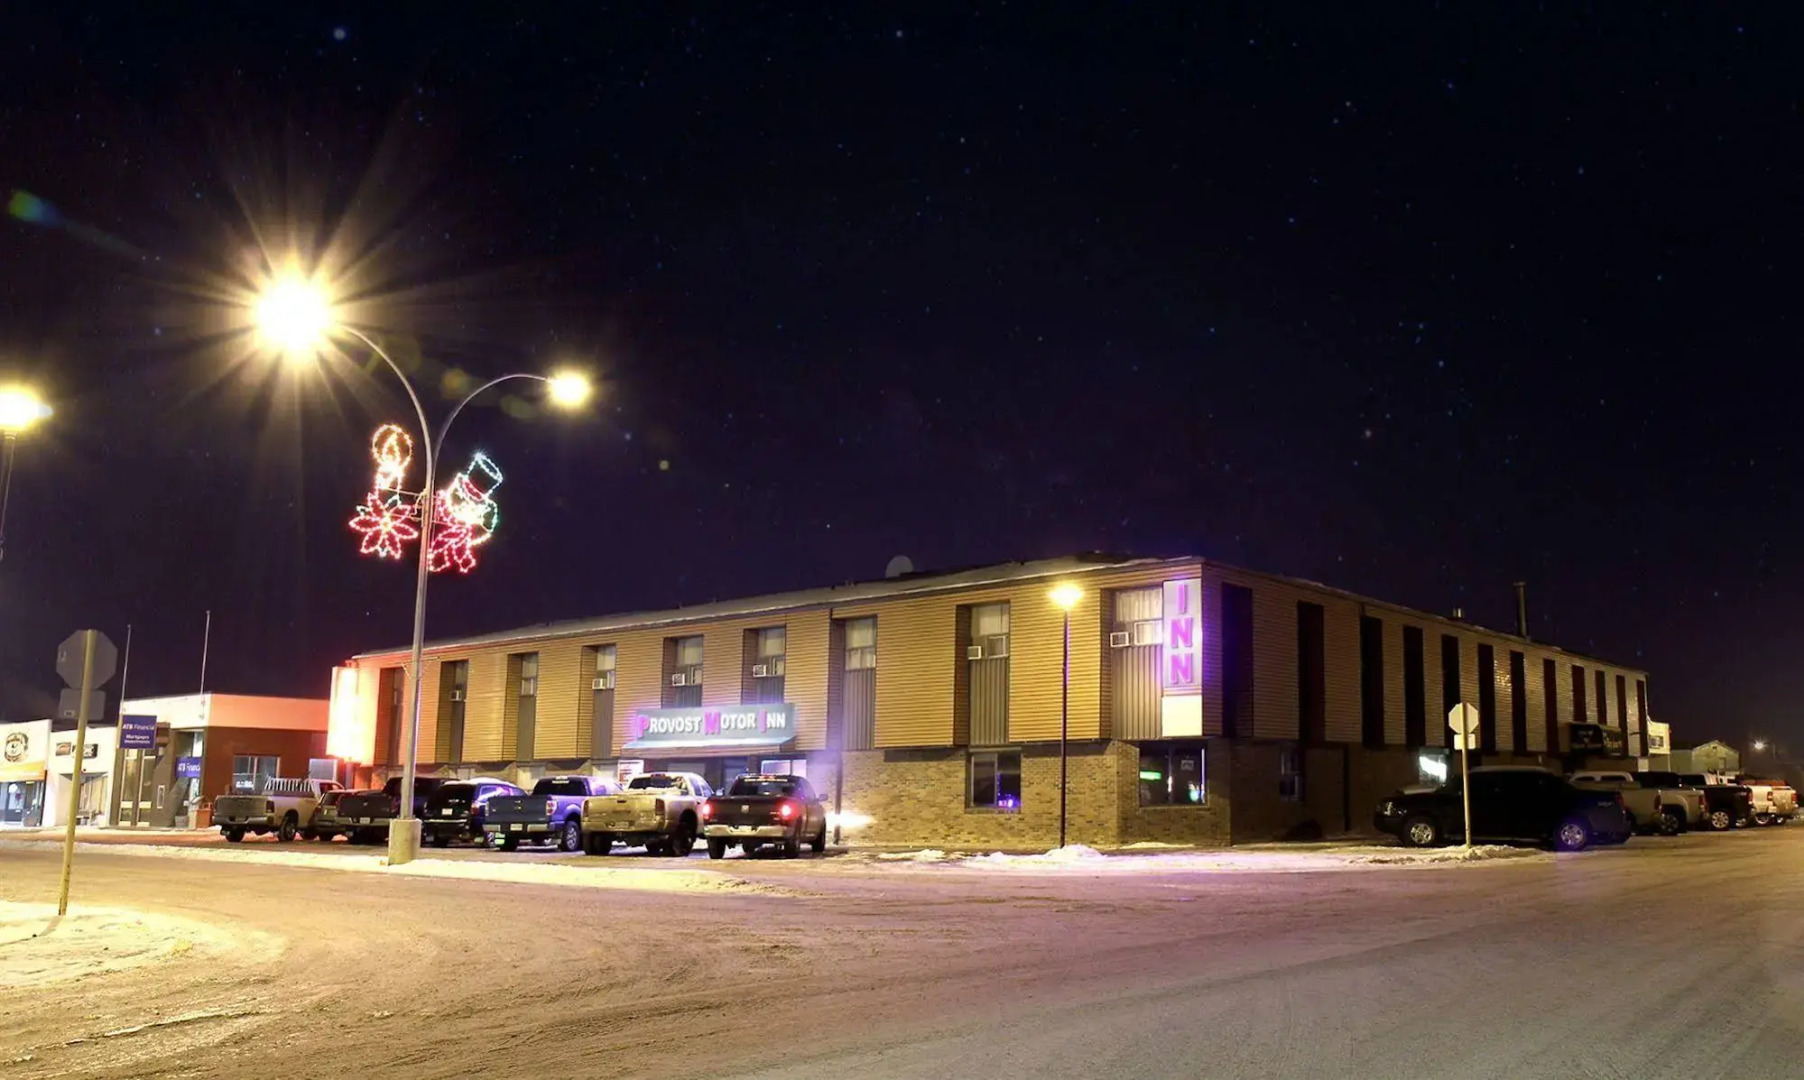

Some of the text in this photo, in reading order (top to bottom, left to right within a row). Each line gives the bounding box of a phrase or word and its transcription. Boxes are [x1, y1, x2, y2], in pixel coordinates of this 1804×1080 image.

[1170, 583, 1193, 685] INN
[637, 709, 786, 738] PROVOST MOTOR INN
